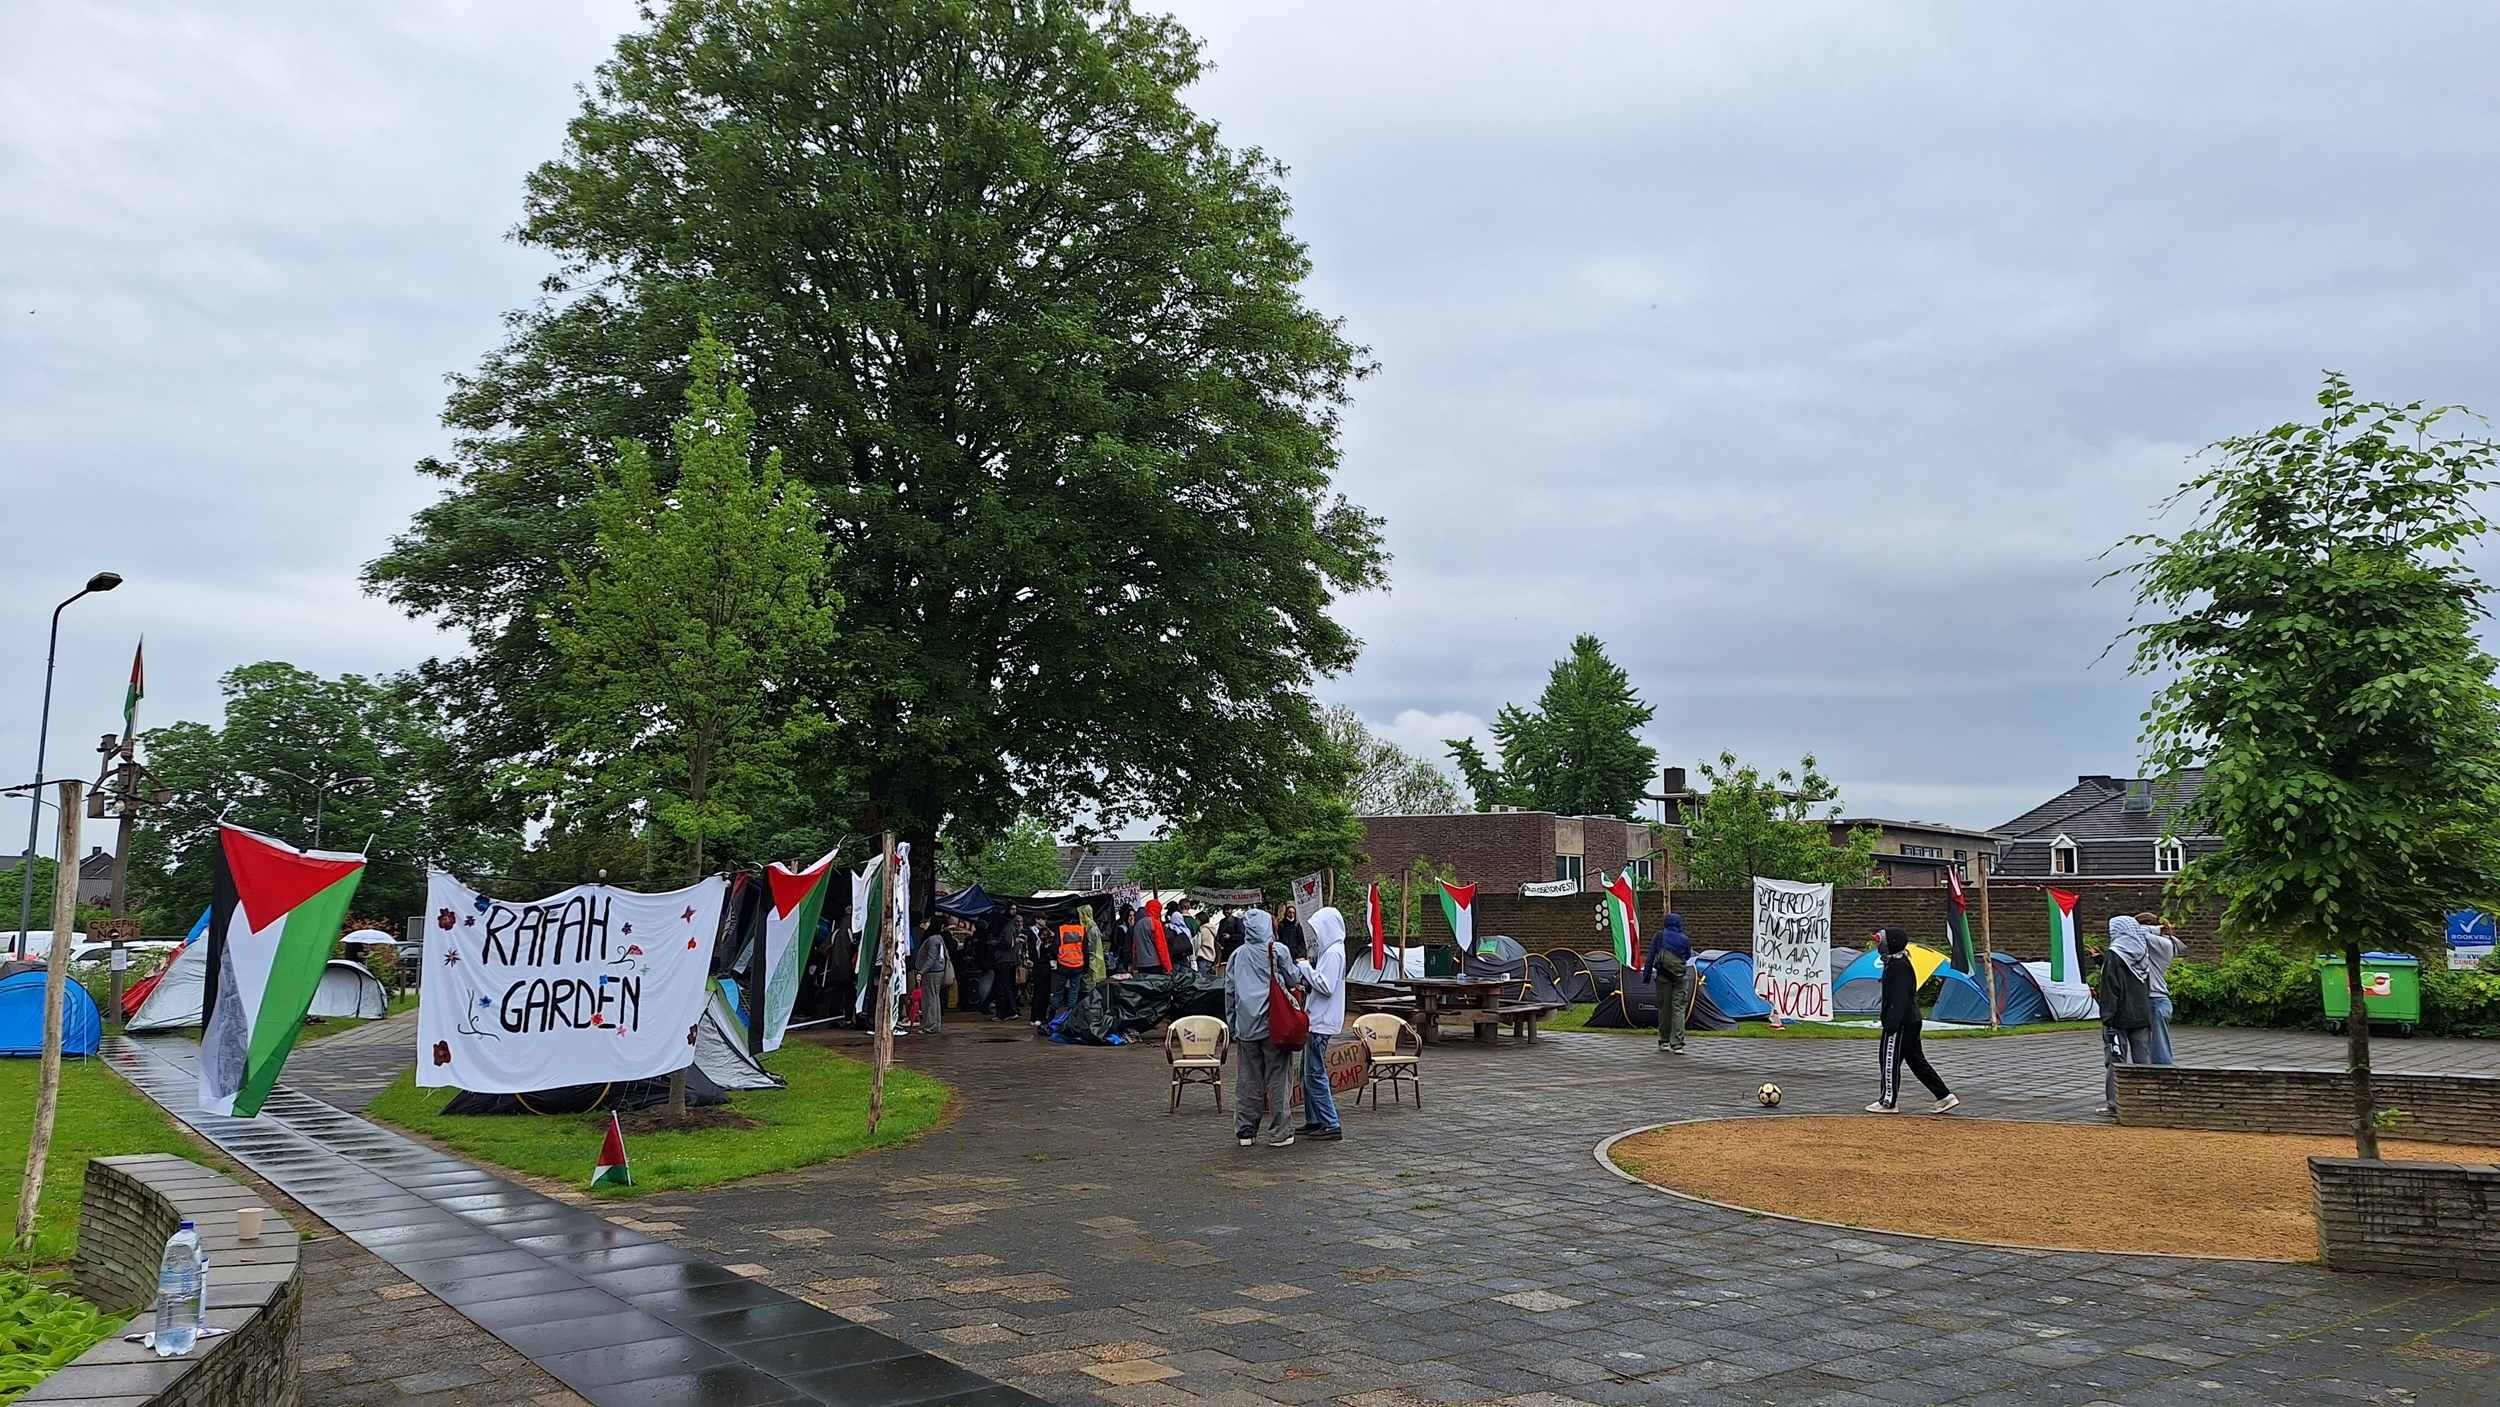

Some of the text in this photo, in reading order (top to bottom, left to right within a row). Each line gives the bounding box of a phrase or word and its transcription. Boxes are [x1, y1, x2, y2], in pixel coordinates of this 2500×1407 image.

[90, 920, 141, 930] CEASEFIRE
[97, 929, 134, 940] NOW
[482, 895, 611, 966] RAFAH
[1785, 963, 1800, 975] do
[1803, 967, 1824, 981] for
[499, 975, 642, 1034] GARDEN
[1754, 971, 1830, 1018] GENOCIDE
